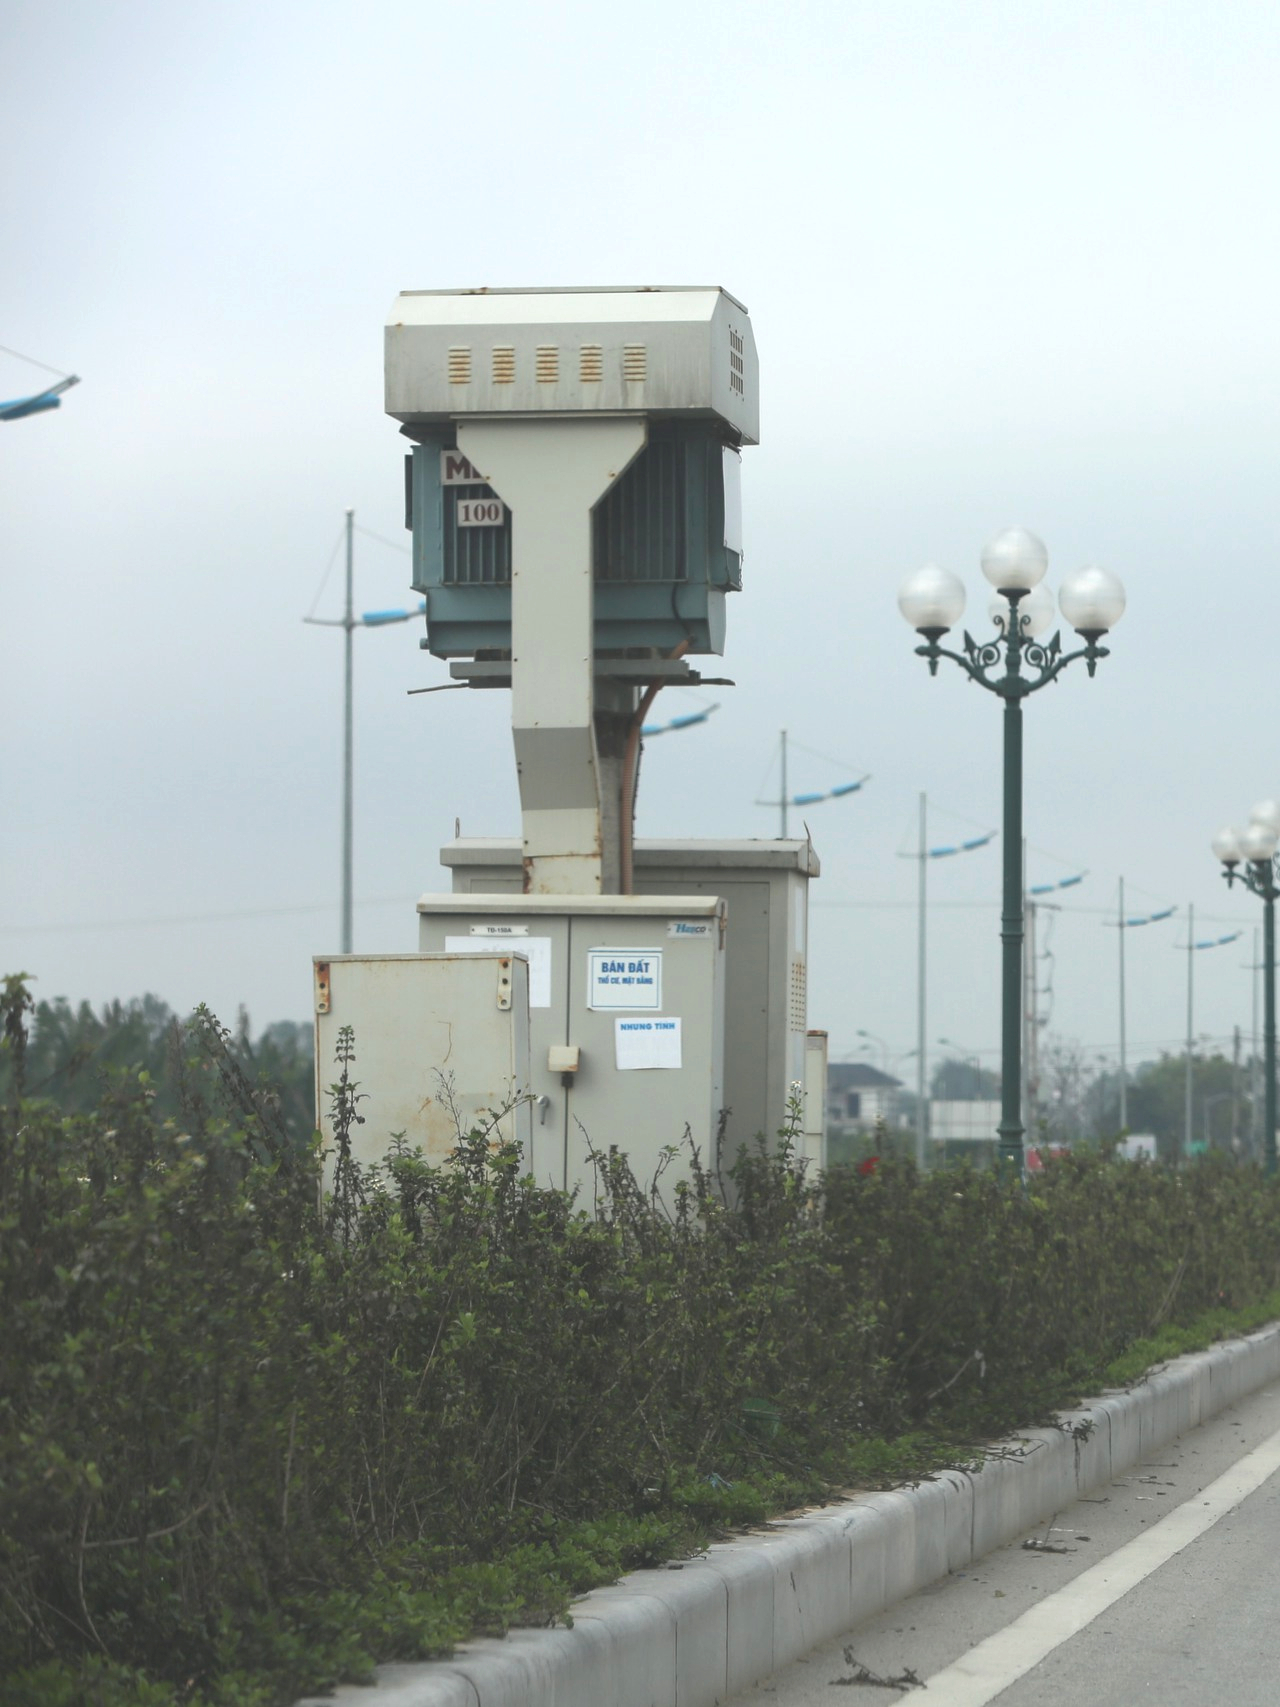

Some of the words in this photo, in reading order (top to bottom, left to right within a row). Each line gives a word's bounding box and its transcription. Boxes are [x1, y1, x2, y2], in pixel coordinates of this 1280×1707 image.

[462, 503, 499, 522] 100
[601, 960, 625, 973] BÁN
[628, 959, 650, 973] ĐẤT
[620, 1023, 652, 1031] NHUNG
